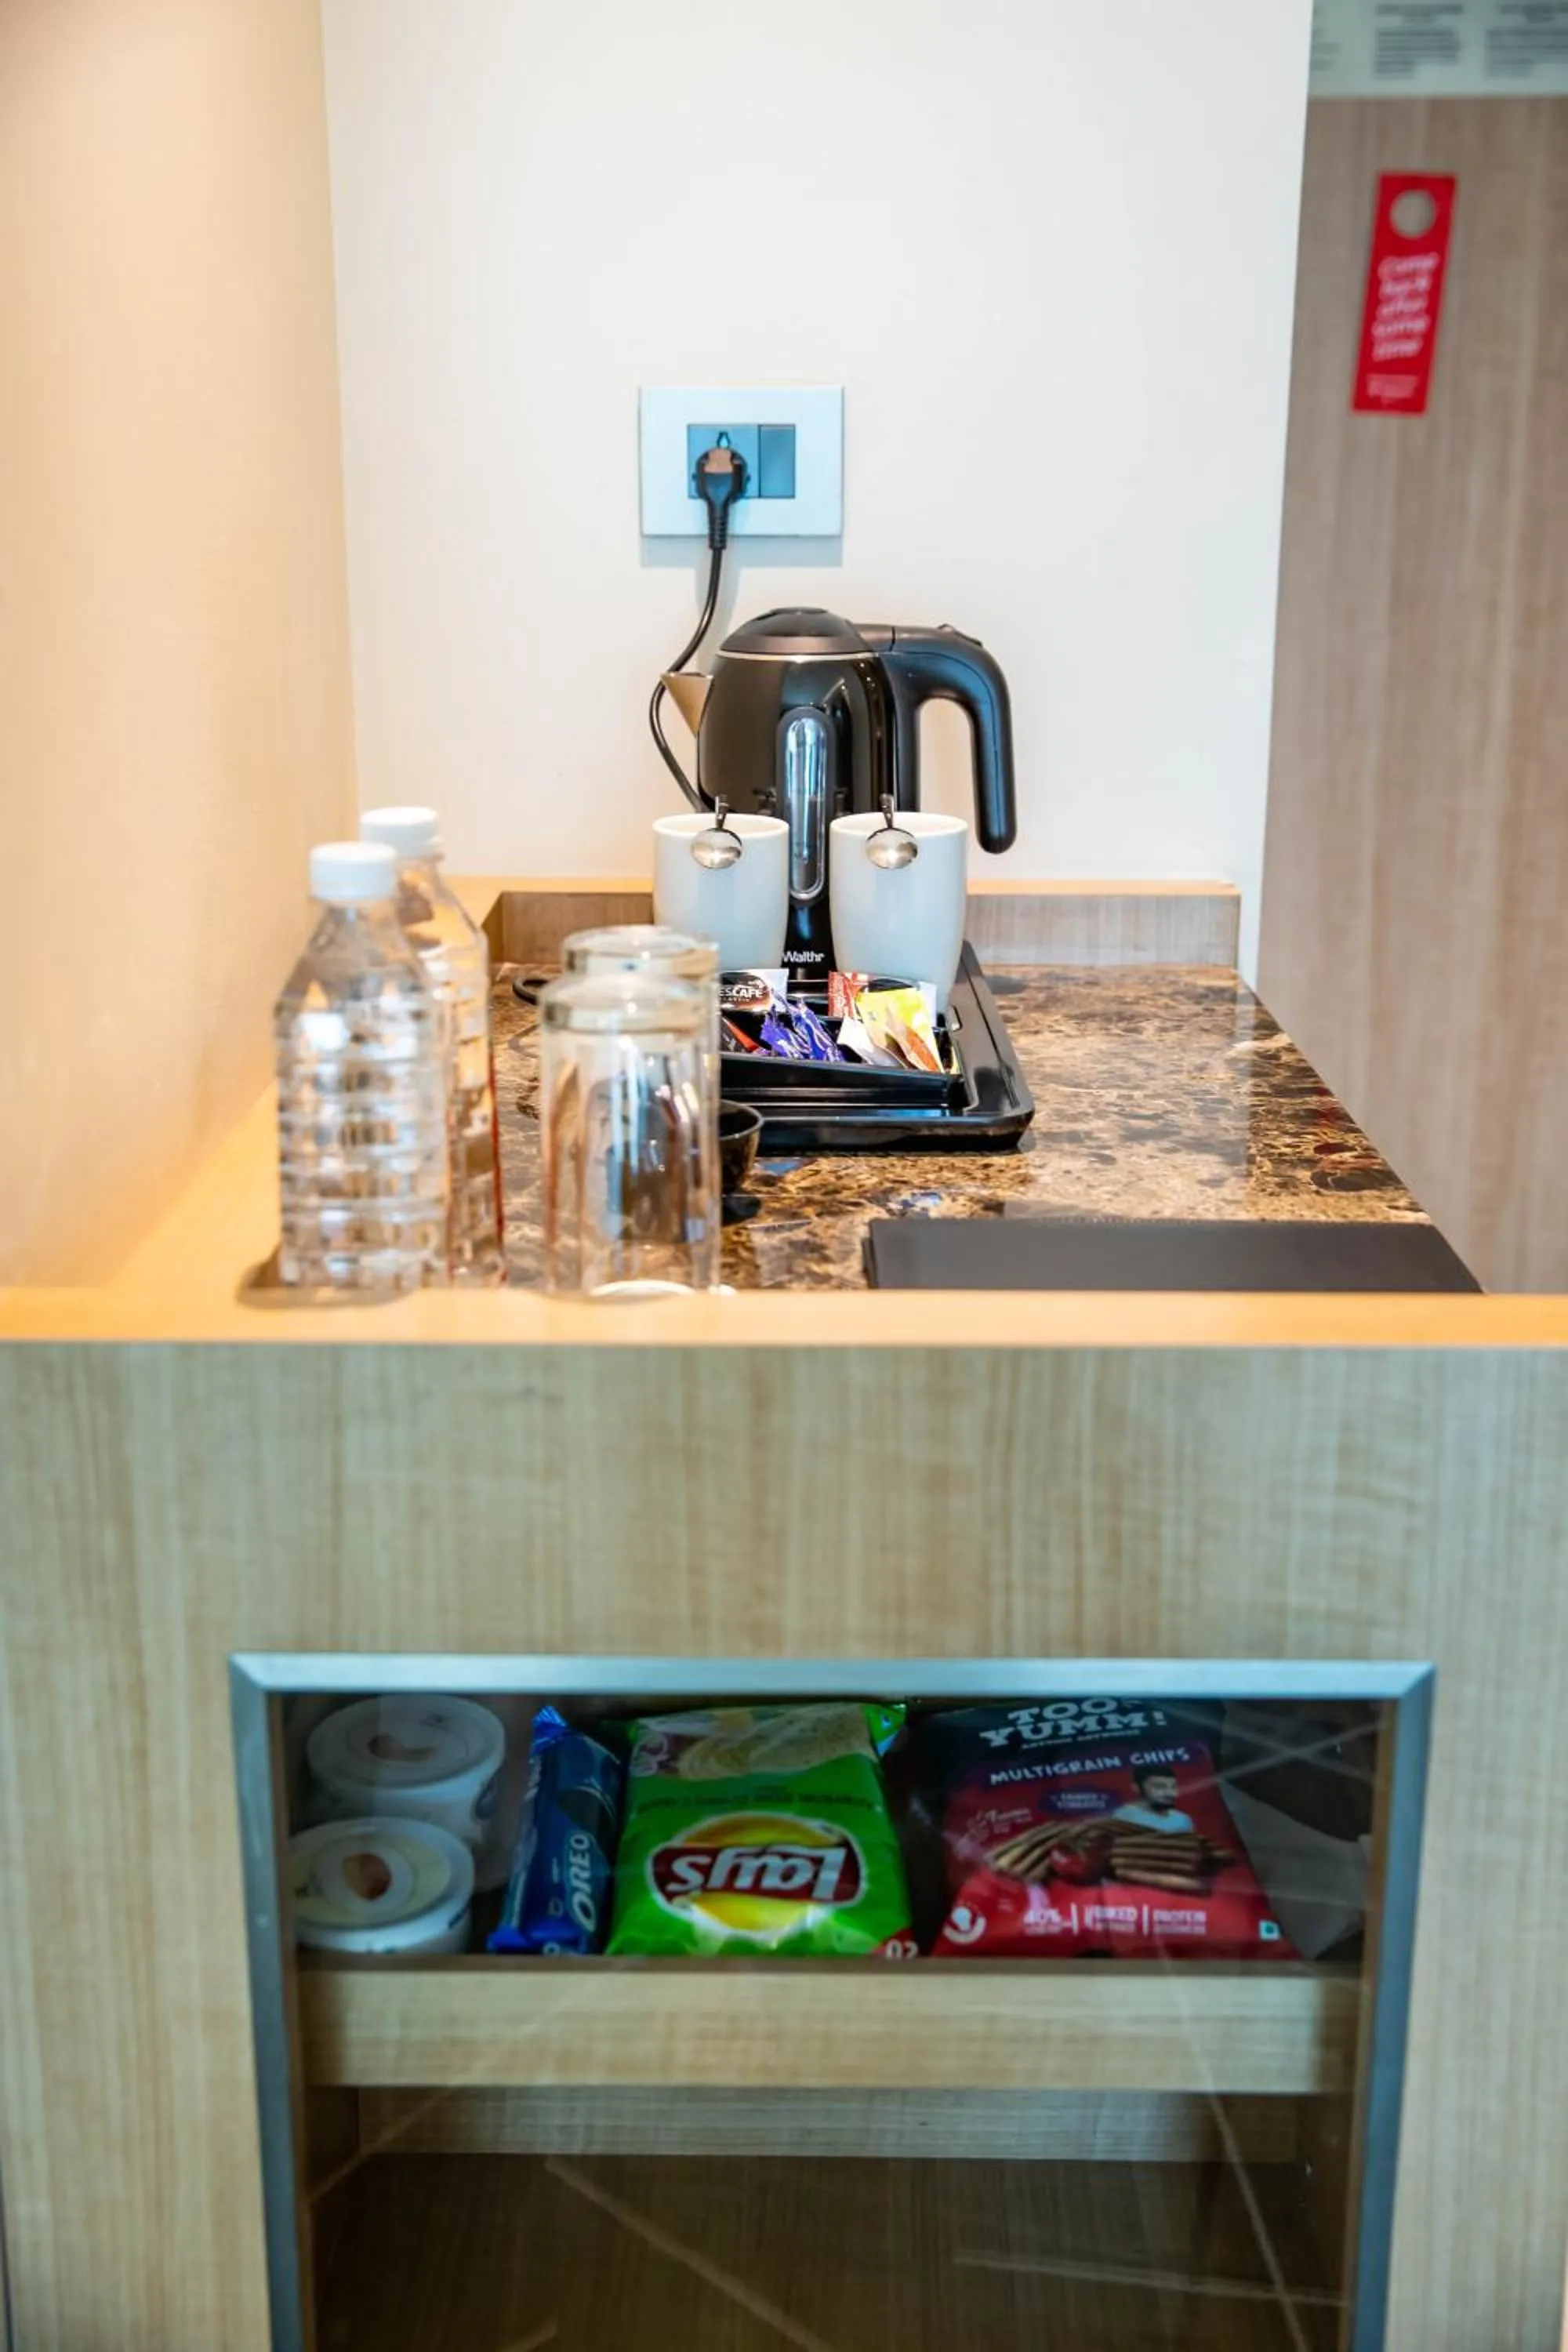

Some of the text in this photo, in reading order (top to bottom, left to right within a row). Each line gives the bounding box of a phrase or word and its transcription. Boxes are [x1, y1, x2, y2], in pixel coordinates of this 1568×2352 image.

[1007, 1697, 1118, 1726] TOO
[990, 1747, 1191, 1785] MULTIGRAIN CHIPS
[568, 1833, 597, 1933] OREO
